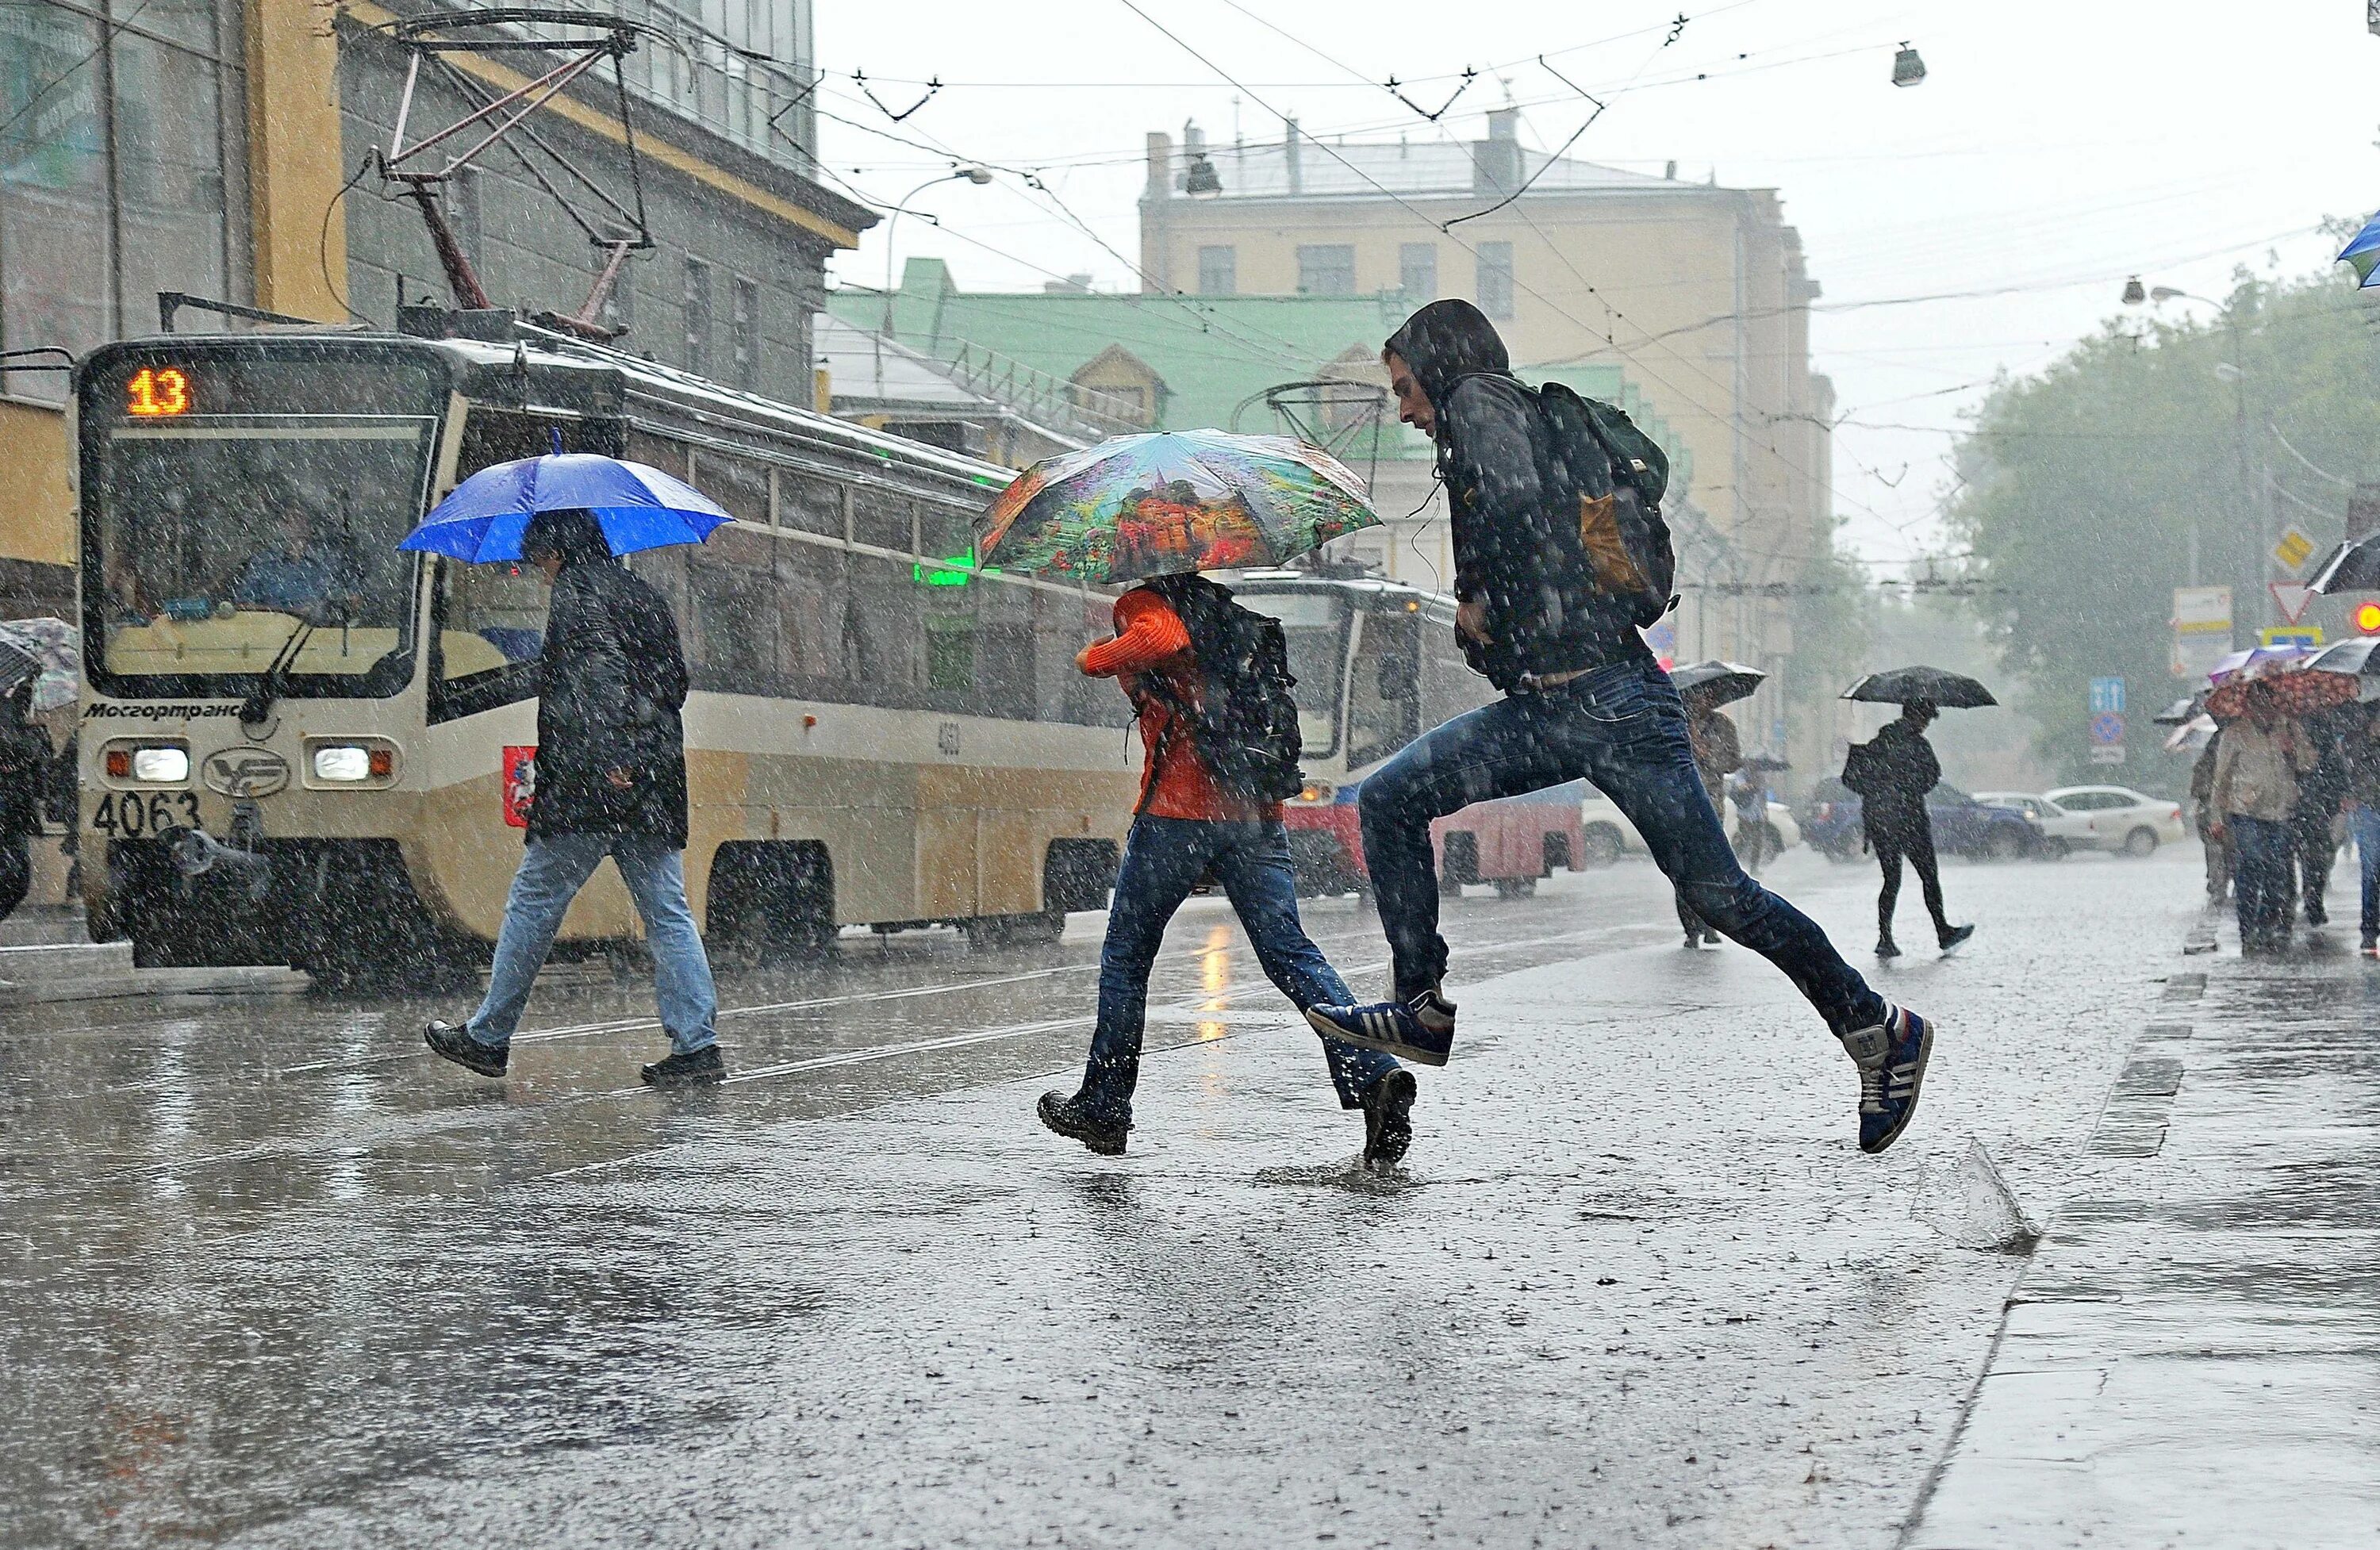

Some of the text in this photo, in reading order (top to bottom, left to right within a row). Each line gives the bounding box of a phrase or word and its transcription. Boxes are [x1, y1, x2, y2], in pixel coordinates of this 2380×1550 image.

[129, 367, 187, 413] 13
[83, 703, 240, 721] Мосгортранс
[94, 791, 202, 836] 4063
